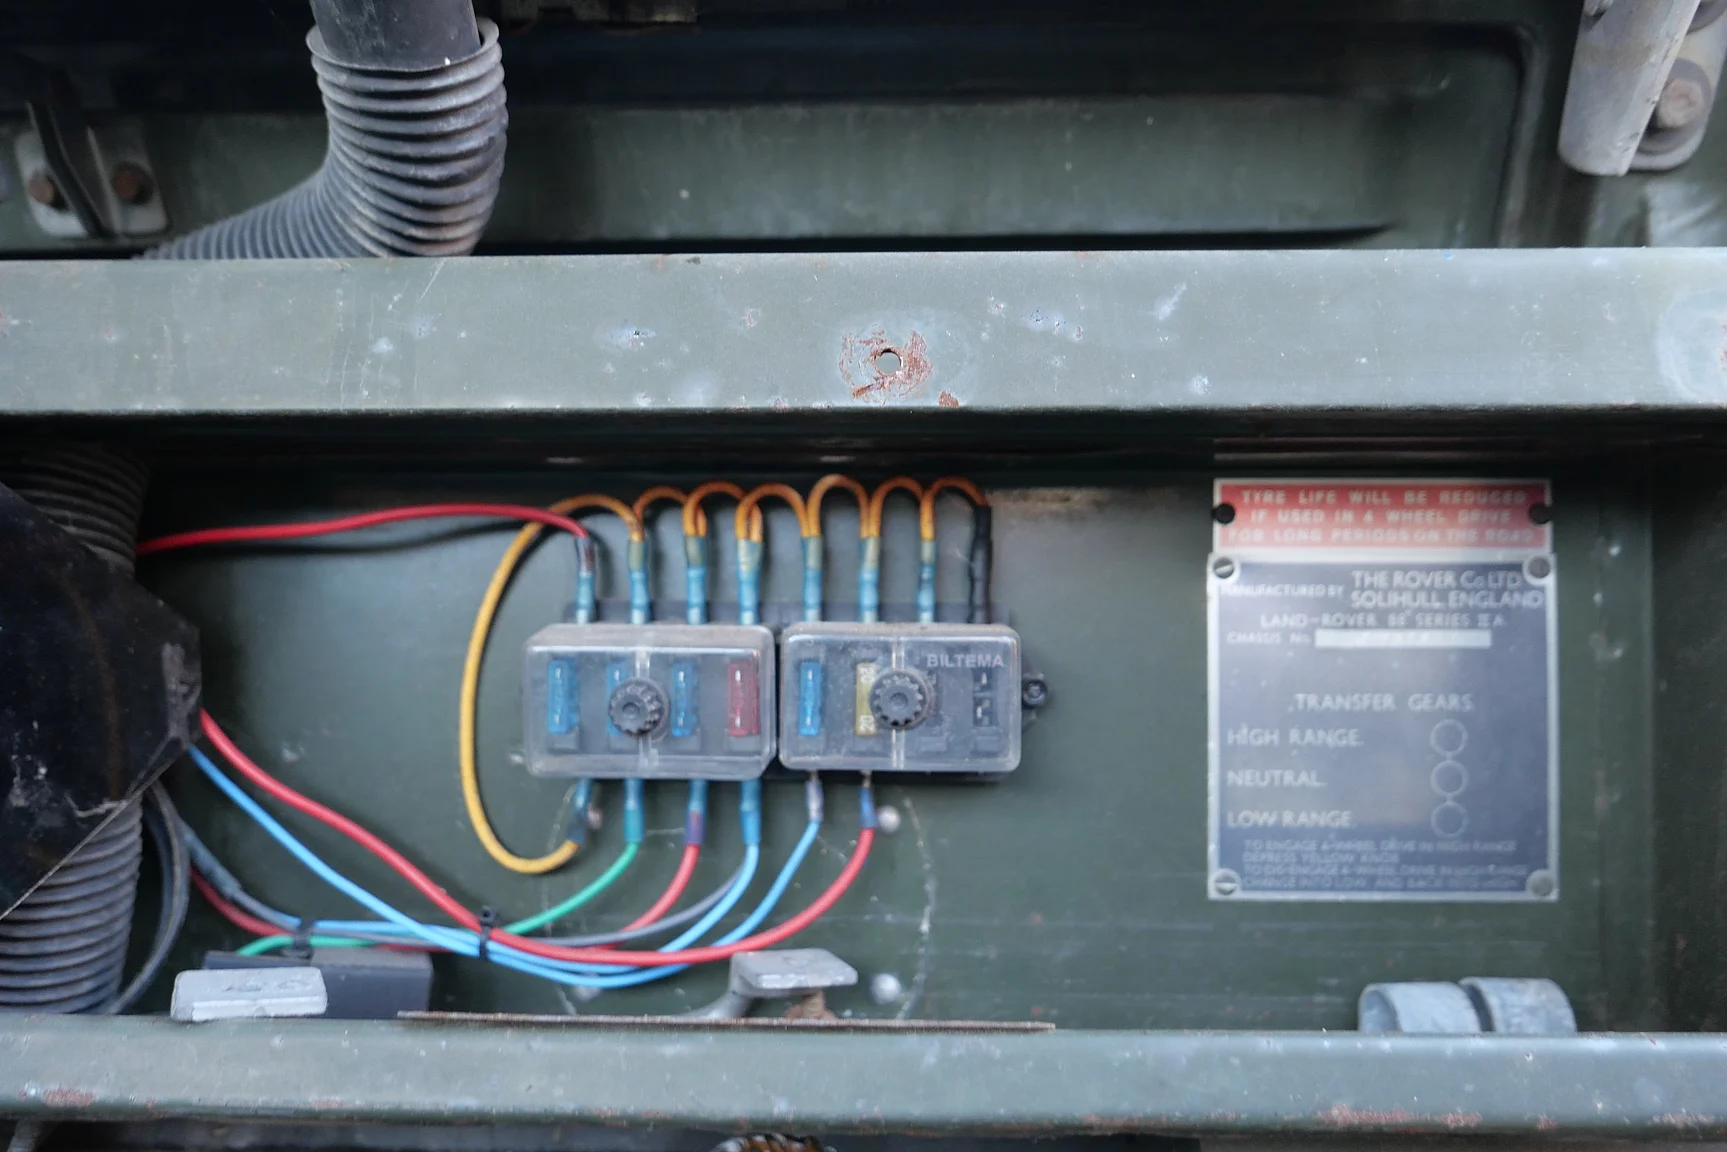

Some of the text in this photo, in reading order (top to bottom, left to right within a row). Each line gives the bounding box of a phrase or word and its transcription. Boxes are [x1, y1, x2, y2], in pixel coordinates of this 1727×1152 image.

[1241, 489, 1528, 505] TYRE LIFE WILL BE REDUCED
[1250, 508, 1268, 523] IF
[1277, 508, 1325, 524] USED
[1334, 509, 1354, 524] IN
[1386, 509, 1445, 524] WHEEL
[1457, 509, 1511, 524] DRIVE
[1228, 528, 1265, 542] FOR
[1273, 528, 1323, 543] LONG
[1330, 528, 1410, 543] PERIODS
[1413, 528, 1440, 543] ON
[1485, 529, 1534, 544] ROAD
[1351, 570, 1389, 589] THE
[1393, 570, 1456, 589] ROVER
[1351, 590, 1545, 609] SOLIHULL ENGLAND
[1415, 613, 1470, 628] SERIES
[926, 654, 1005, 668] BILTEMA
[1294, 693, 1397, 711] TRANSFER
[1227, 728, 1279, 746] HIGH
[1227, 810, 1277, 828] LOW
